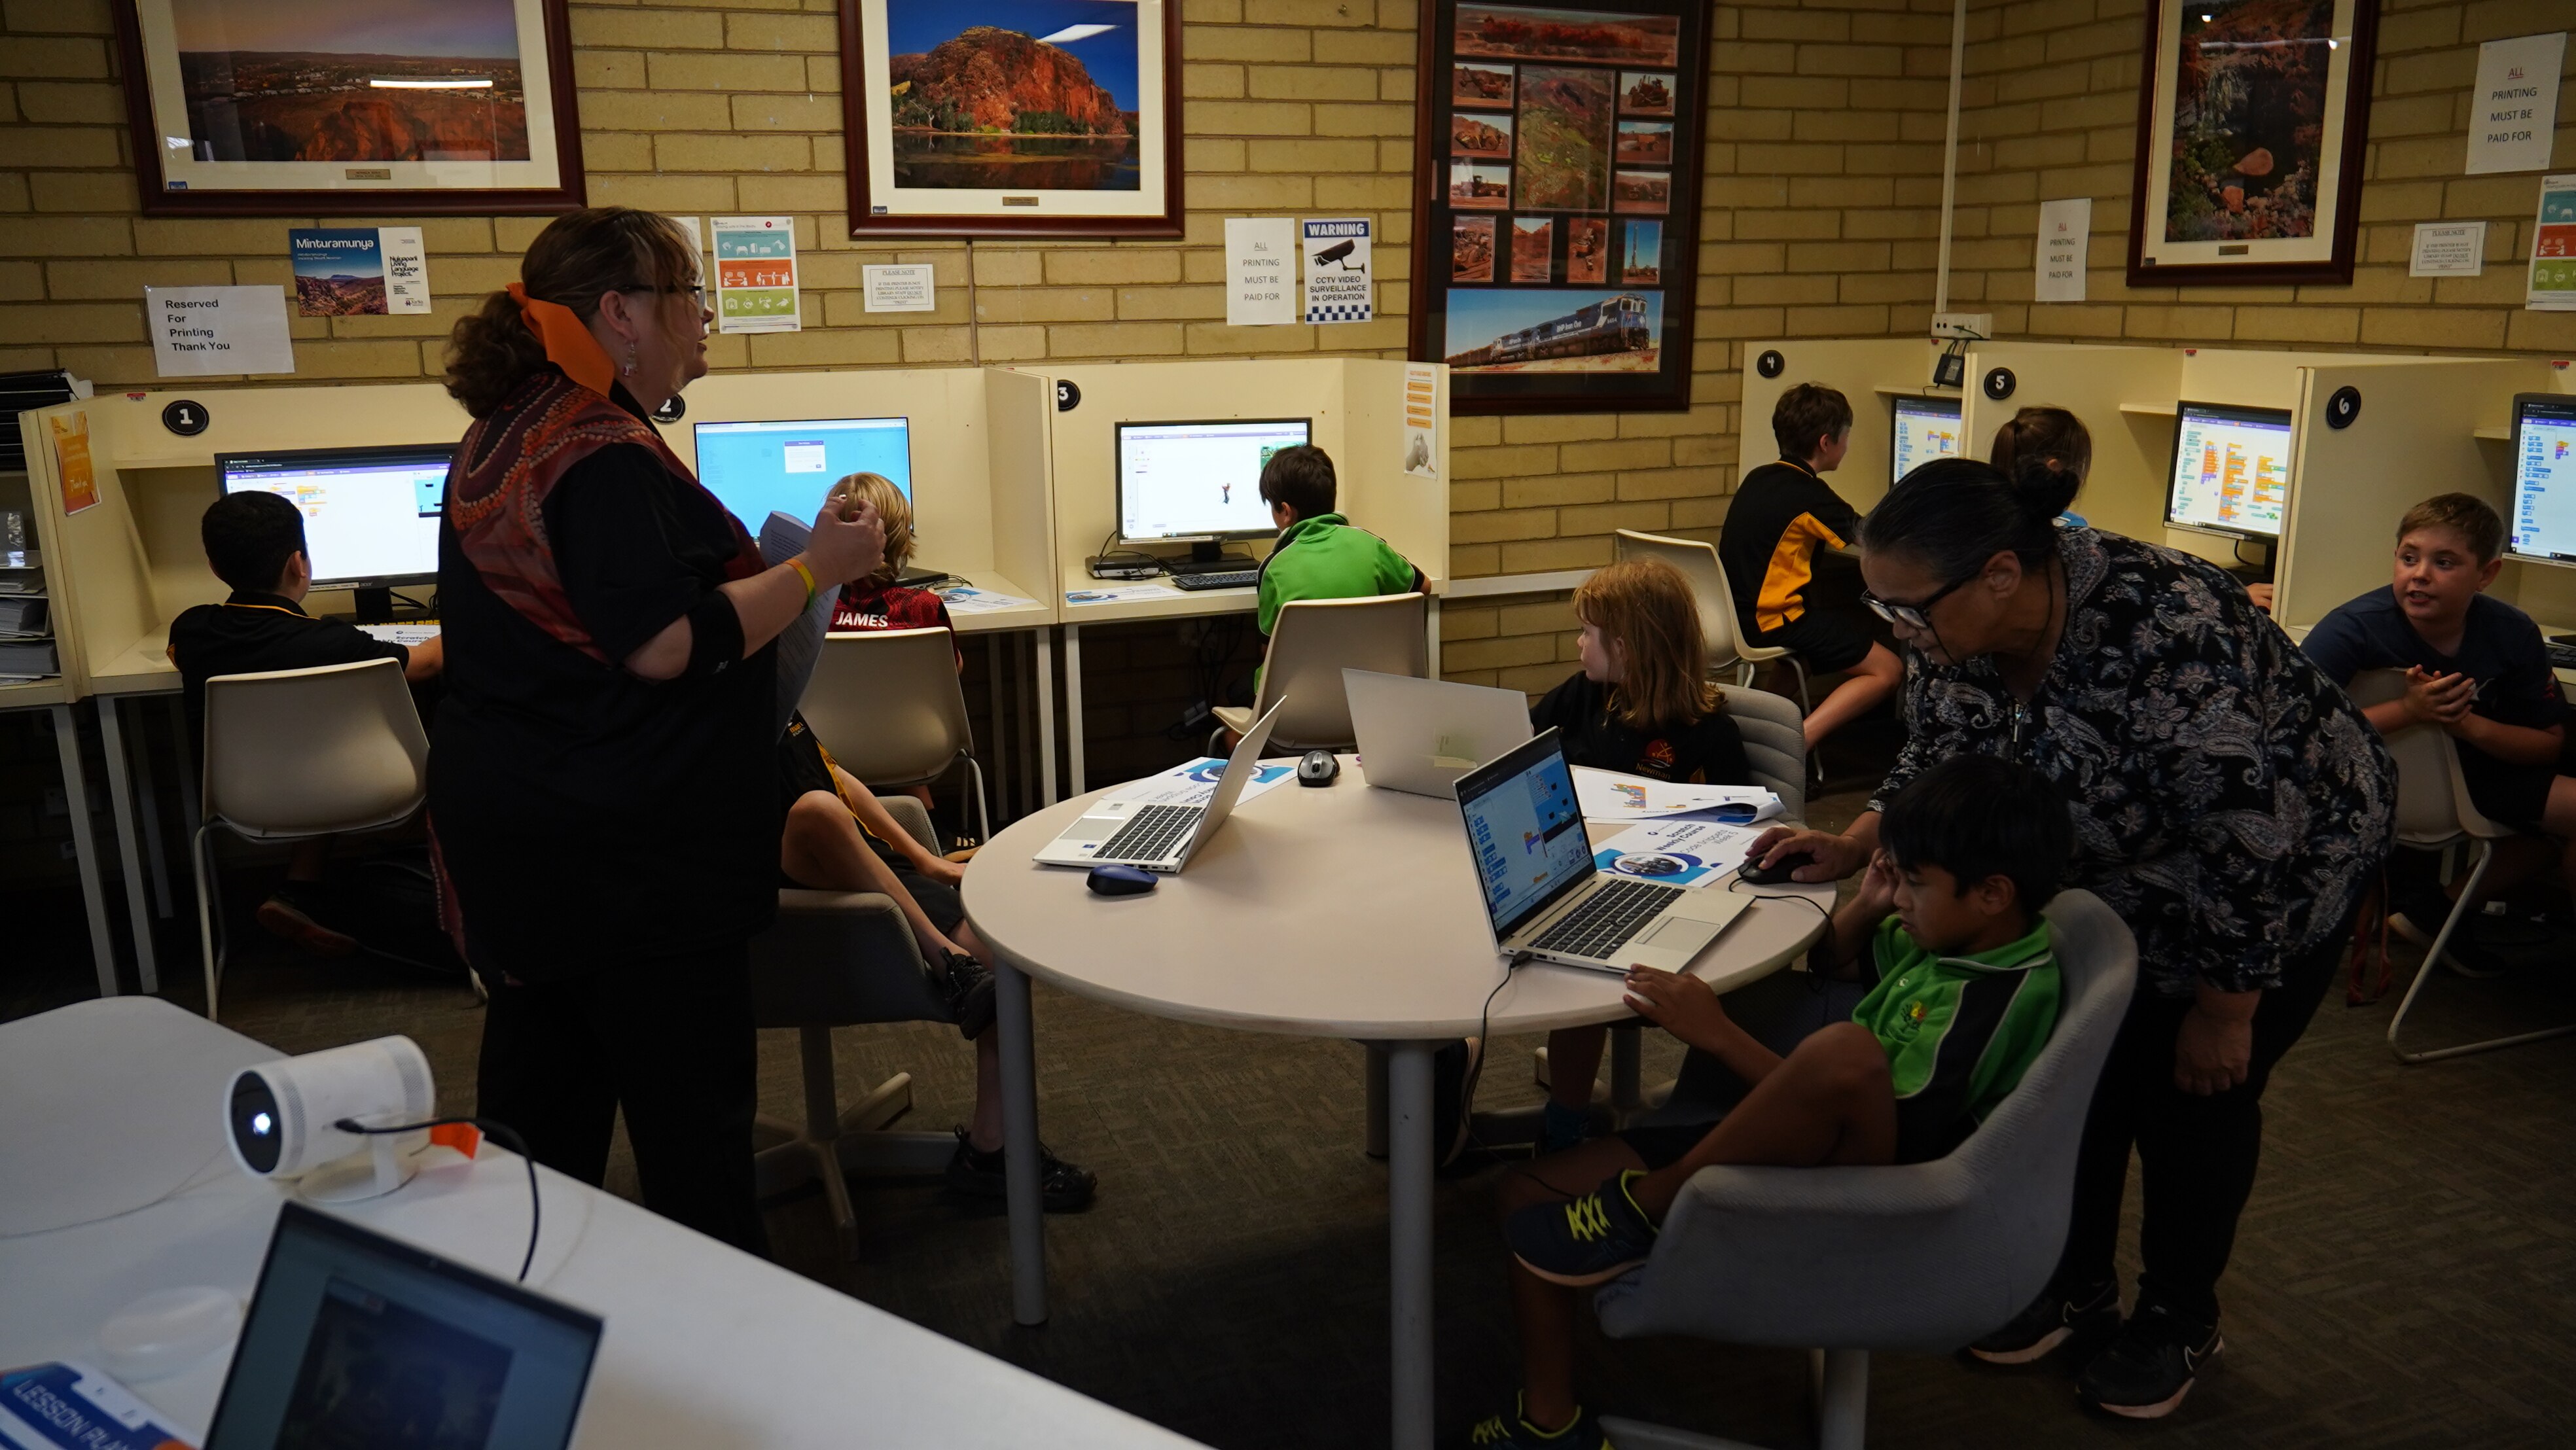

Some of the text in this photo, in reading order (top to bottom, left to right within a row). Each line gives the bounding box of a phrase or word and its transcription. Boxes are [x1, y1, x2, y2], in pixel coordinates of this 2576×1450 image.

[2508, 67, 2524, 77] ALL
[2492, 87, 2537, 100] PRINTING
[2490, 109, 2533, 122] MUST BE
[2488, 131, 2531, 143] PAID FOR
[1308, 223, 1365, 236] WARNING
[296, 238, 374, 250] Minturamunya
[1243, 258, 1280, 267] PRINTING
[1245, 275, 1279, 284] MUST BE
[1310, 284, 1367, 293] SURVEILLANCE
[165, 299, 219, 309] Reserved
[1321, 293, 1365, 302] OPERATION
[168, 314, 186, 323] For
[170, 328, 214, 338] Printing
[171, 342, 230, 351] Thank You
[1767, 356, 1774, 369] 4
[1995, 375, 2005, 390] 5
[1058, 387, 1069, 400] 3
[660, 398, 671, 412] 2
[2339, 397, 2350, 415] 6
[179, 408, 193, 425] 1
[835, 611, 888, 628] JAMES
[1636, 763, 1670, 780] Newman
[1666, 823, 1696, 838] Scratch
[1655, 835, 1686, 851] Weekly
[1683, 826, 1706, 841] Course
[13, 1379, 91, 1437] LESSON
